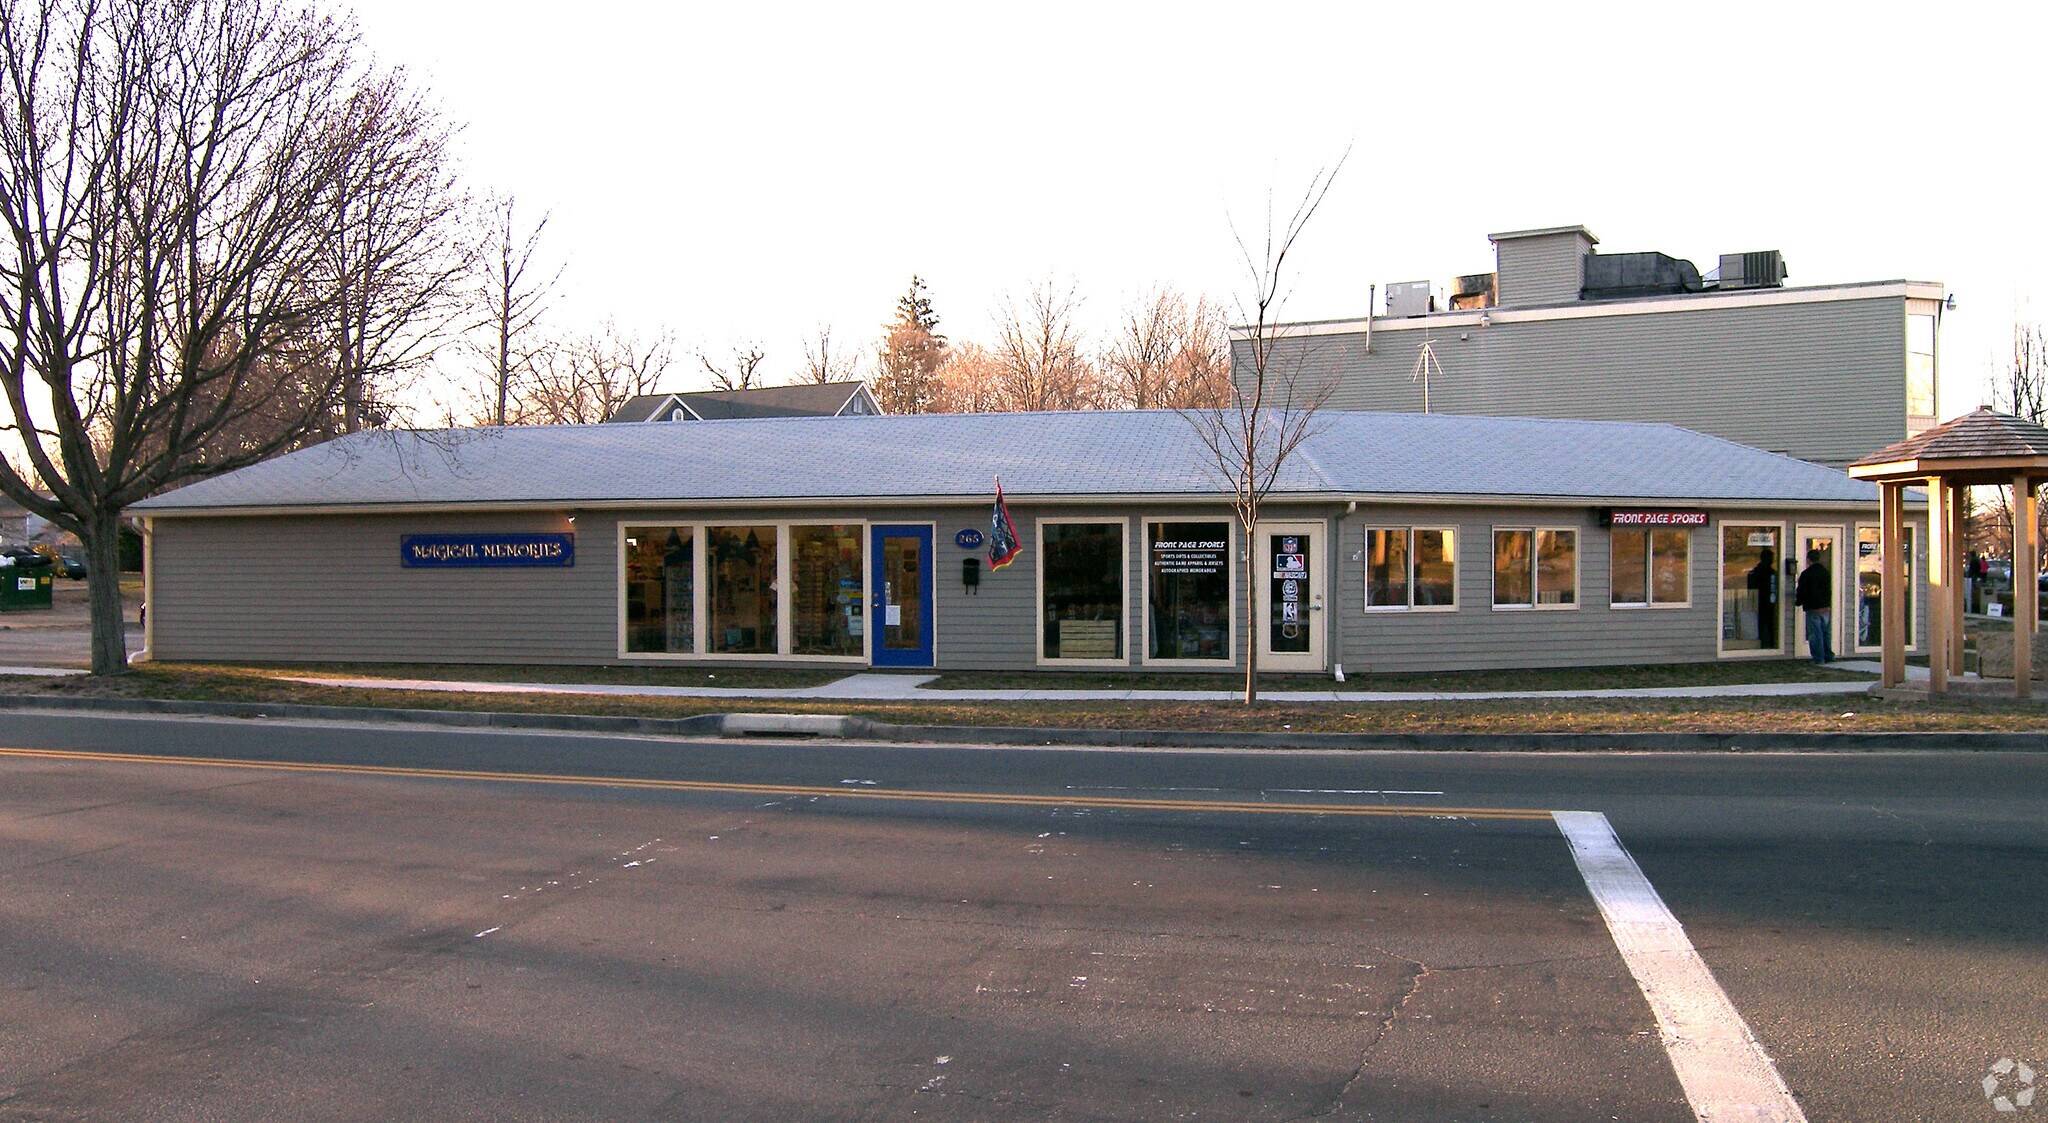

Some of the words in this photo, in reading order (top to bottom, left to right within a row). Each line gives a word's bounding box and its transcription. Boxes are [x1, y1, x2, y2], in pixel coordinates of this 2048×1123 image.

[1613, 514, 1643, 523] FRONT
[1644, 514, 1668, 523] PAGE
[1671, 514, 1705, 523] SPORTS
[959, 535, 979, 543] 265
[412, 544, 479, 560] MAGICAL
[481, 542, 562, 559] MEMORIES
